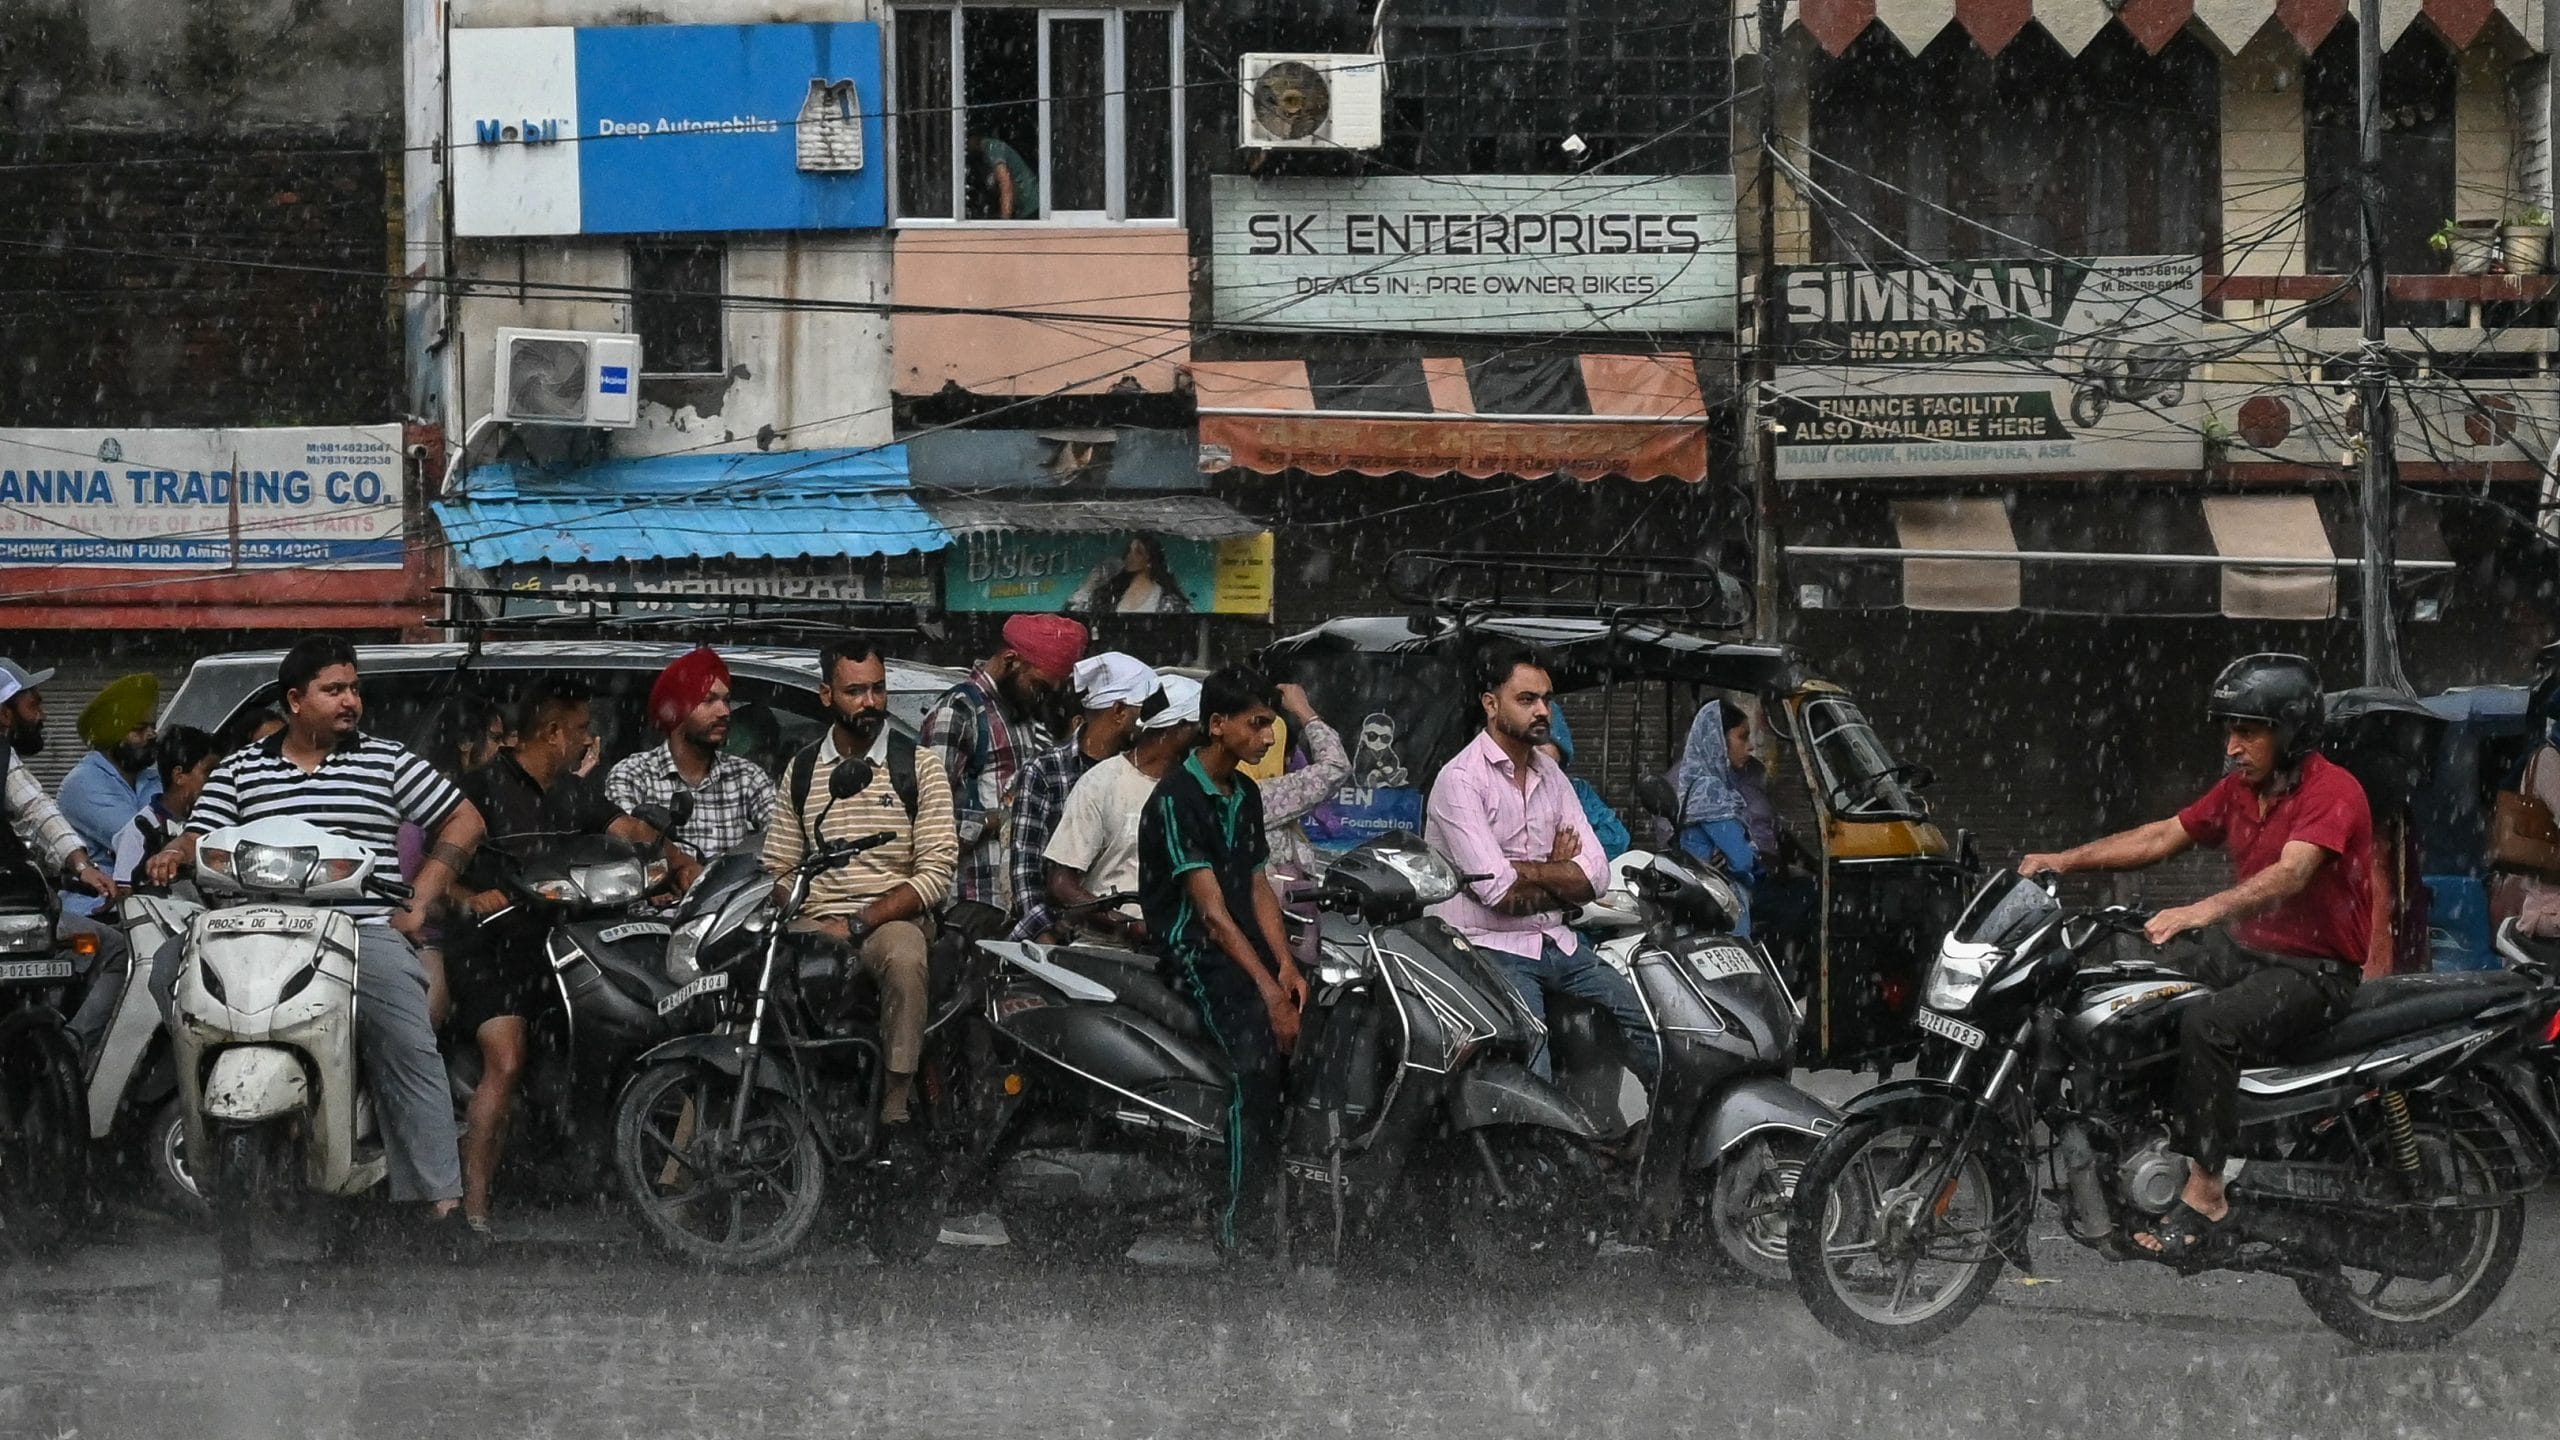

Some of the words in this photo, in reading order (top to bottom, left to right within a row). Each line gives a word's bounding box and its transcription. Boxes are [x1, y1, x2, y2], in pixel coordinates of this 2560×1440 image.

[600, 118, 650, 139] Deep
[655, 115, 778, 134] Automobiles
[1248, 214, 1319, 255] SK
[1346, 213, 1702, 255] ENTERPRISES
[1297, 276, 1379, 294] DEALS
[1426, 277, 1477, 294] PRE
[1483, 276, 1575, 294] OWNER
[1582, 276, 1655, 294] BIKES
[1786, 267, 2053, 323] SIMRAN
[1850, 329, 1987, 359] MOTORS
[600, 375, 628, 385] Haier
[1818, 398, 1916, 418] FINANCE
[1922, 396, 2020, 416] FACILITY
[1795, 420, 1853, 440] ALSO
[1859, 418, 1981, 439] AVAILABLE
[1987, 416, 2047, 436] HERE
[1785, 447, 1828, 465] MAIN
[0, 469, 113, 504] ANNA
[126, 469, 309, 504] TRADING
[325, 470, 392, 504] CO.
[69, 514, 102, 531] ALL
[109, 515, 159, 532] TYPE
[167, 515, 192, 532] OF
[313, 515, 375, 532] PARTS
[61, 543, 133, 558] HUSSAIN
[138, 543, 183, 558] PURA
[1333, 787, 1373, 806] EN
[1340, 817, 1414, 830] Foundation
[246, 908, 287, 916] HONDA
[207, 918, 236, 929] PB02
[288, 918, 314, 929] 1306
[1304, 1167, 1349, 1186] ZELO
